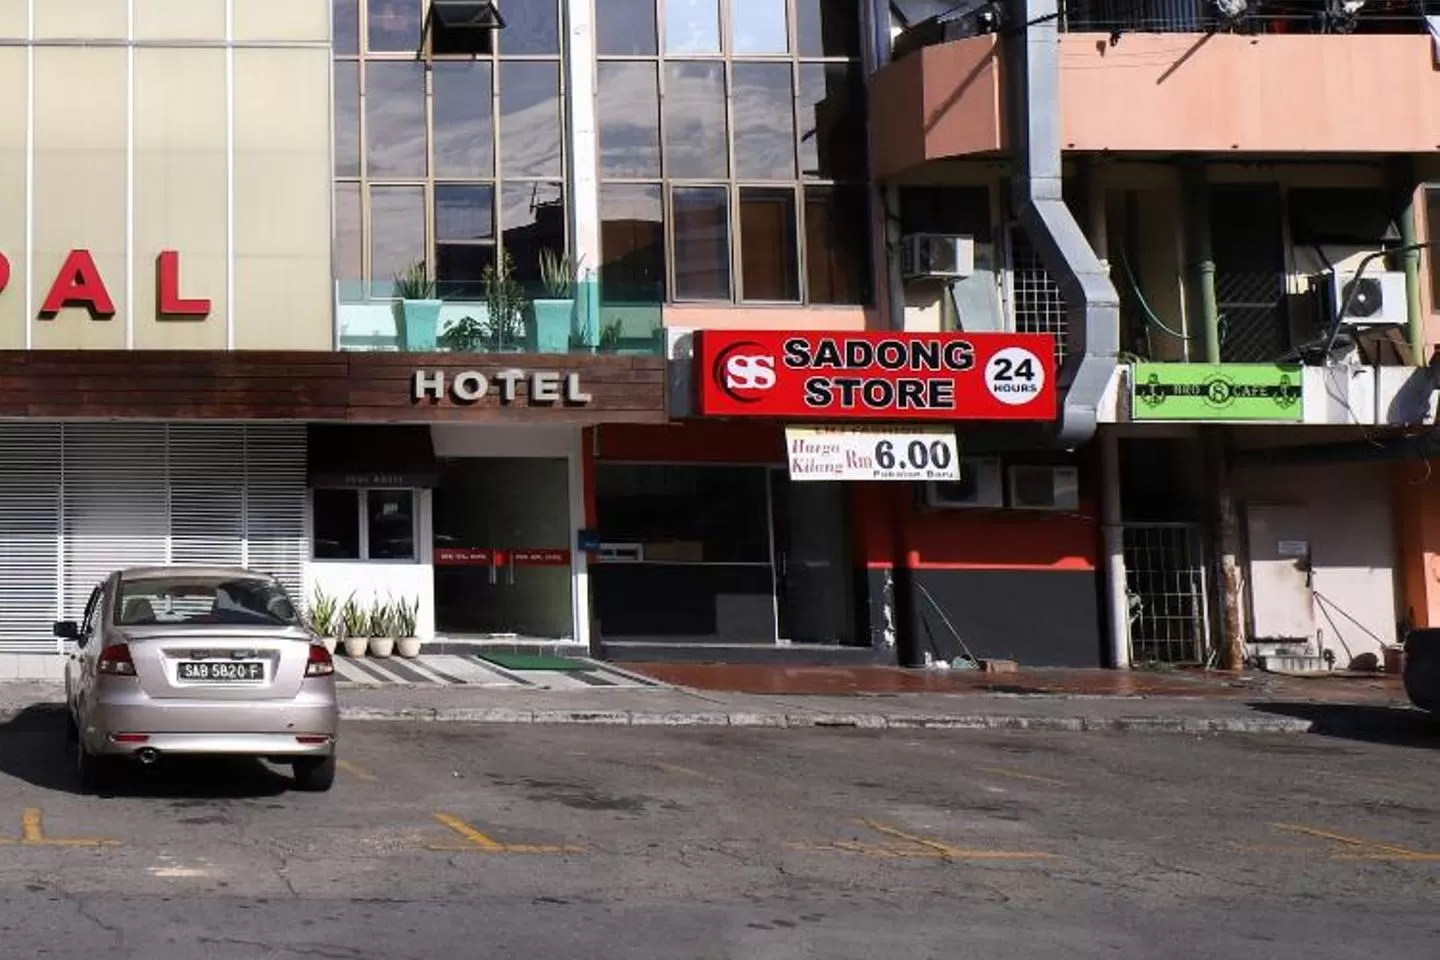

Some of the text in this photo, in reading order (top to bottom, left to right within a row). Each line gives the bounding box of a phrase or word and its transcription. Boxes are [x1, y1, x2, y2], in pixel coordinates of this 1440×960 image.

[783, 338, 976, 372] SADONG
[726, 354, 777, 390] SS
[993, 358, 1035, 381] 24
[412, 370, 593, 405] HOTEL
[803, 376, 956, 410] STORE
[994, 383, 1038, 393] HOURS
[792, 439, 841, 454] Harga
[874, 440, 952, 470] 6.00
[791, 457, 844, 474] Kilang
[185, 664, 208, 678] SAB
[249, 664, 258, 678] F
